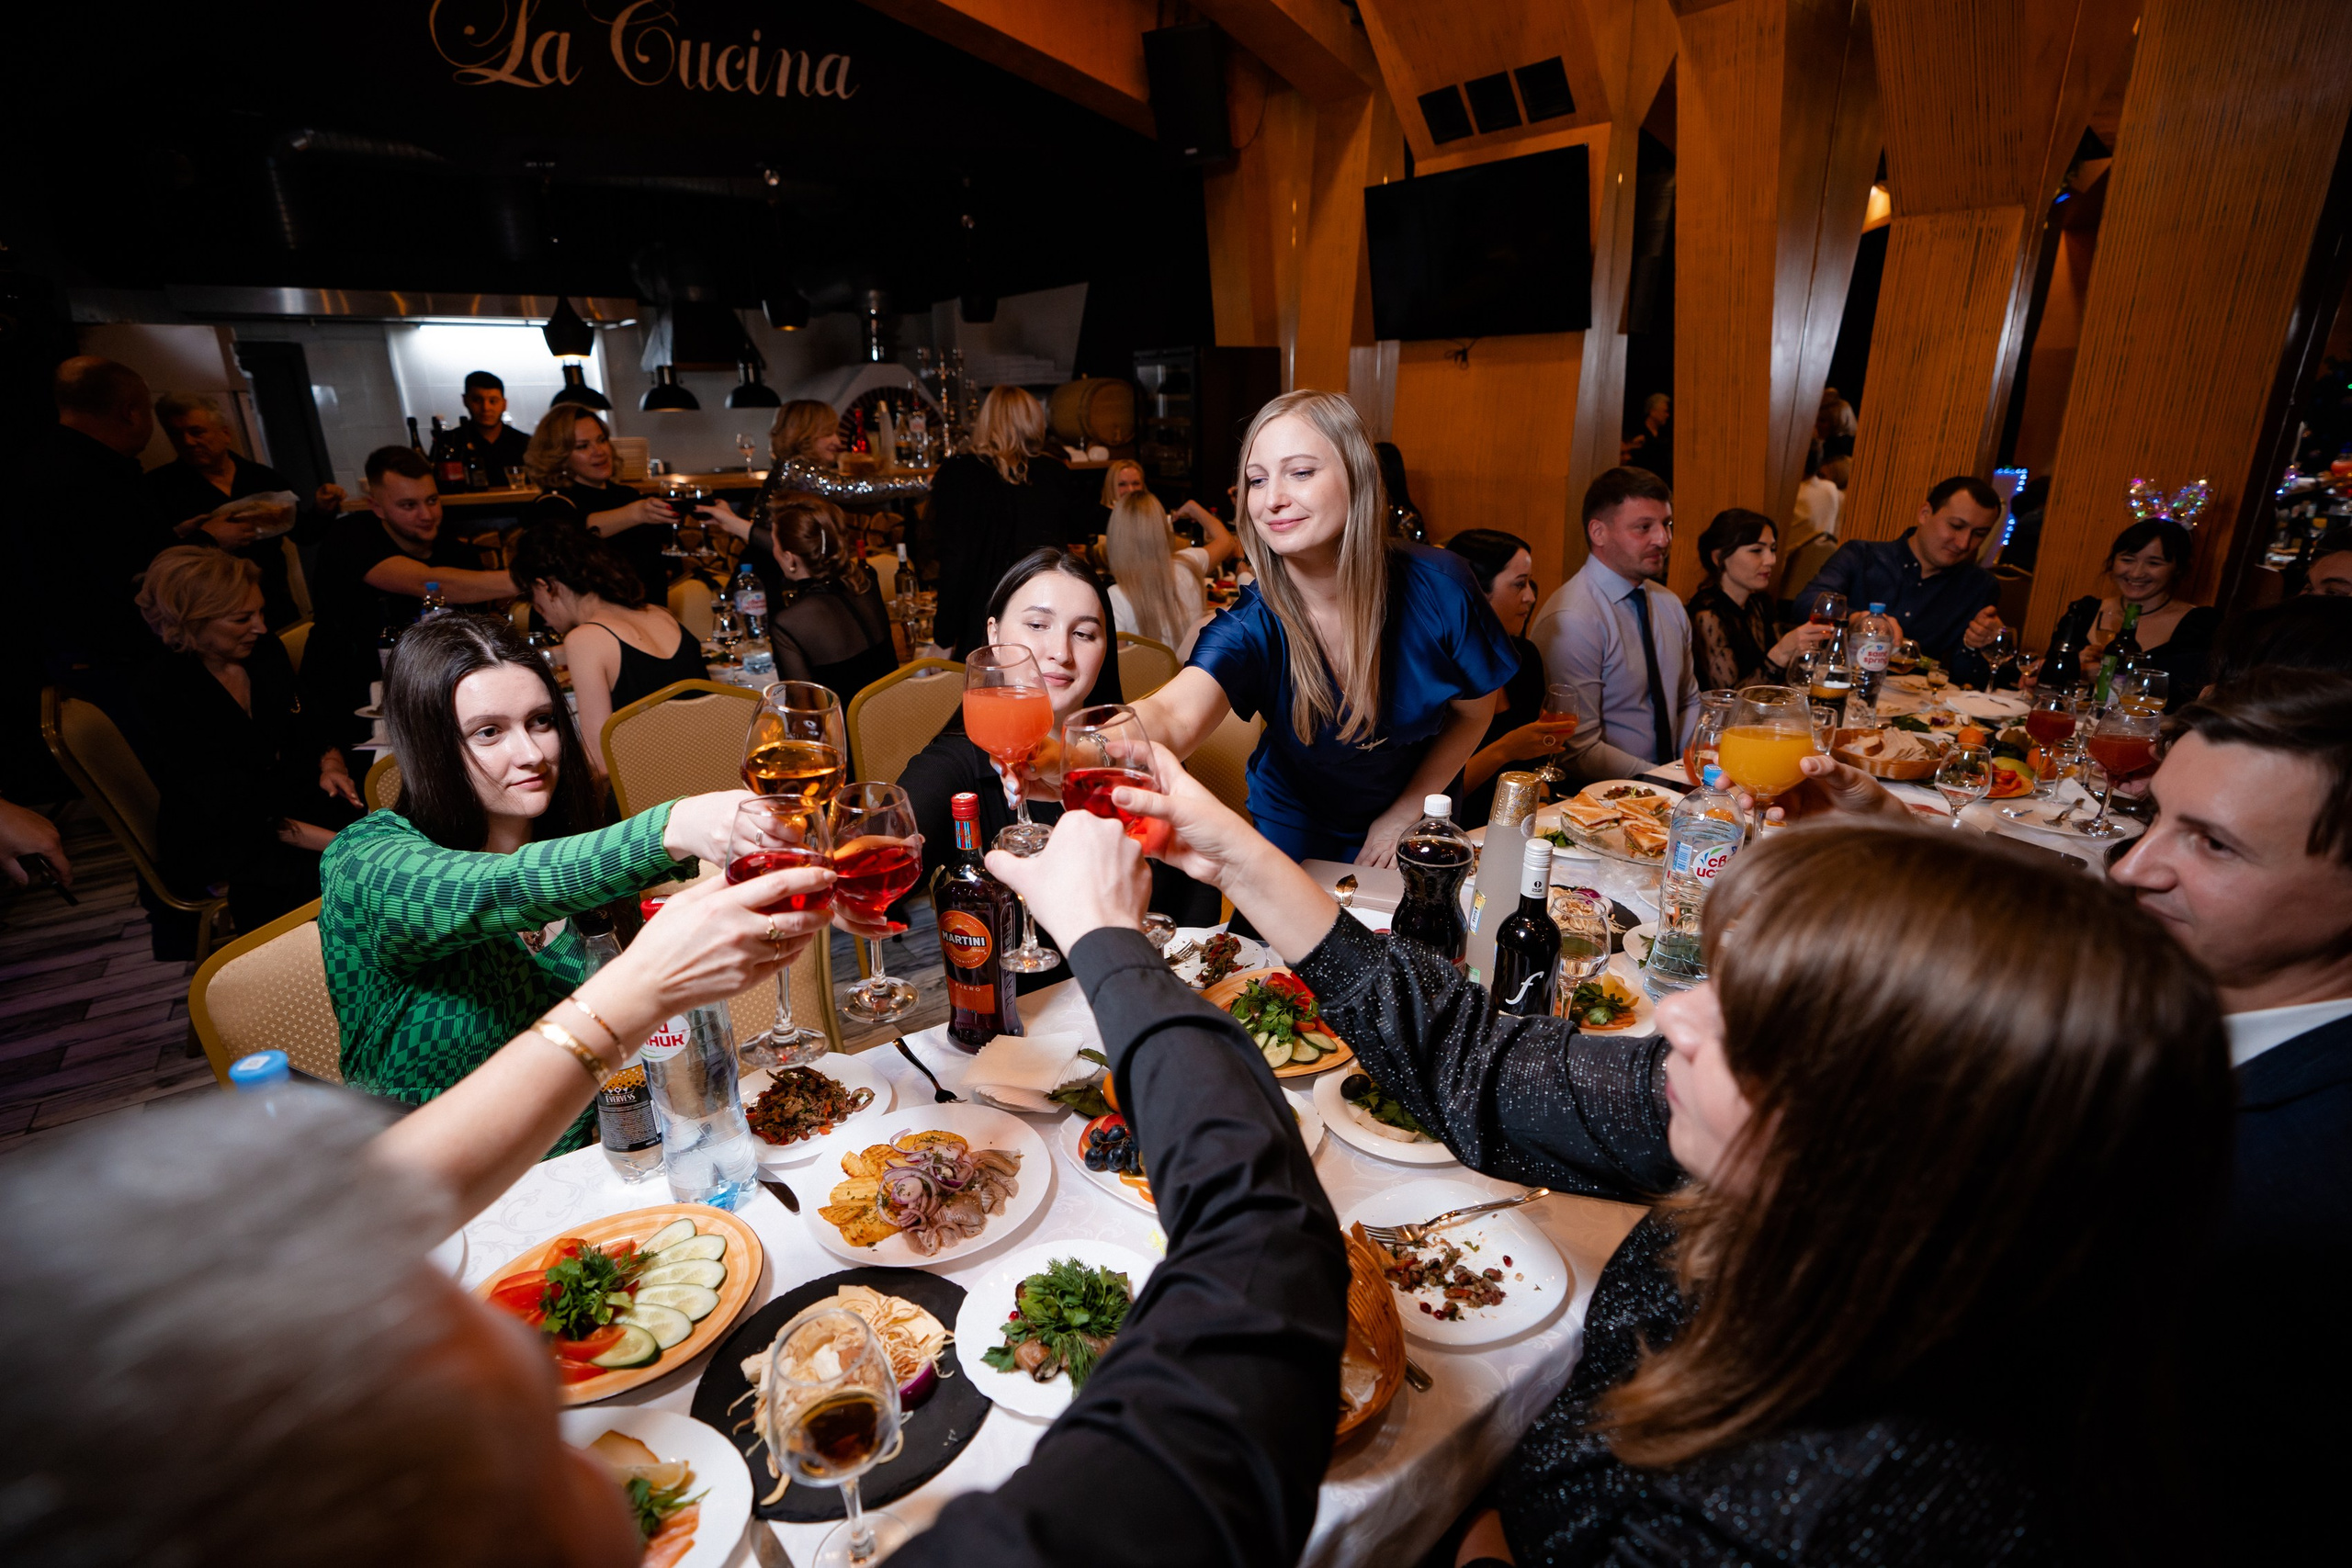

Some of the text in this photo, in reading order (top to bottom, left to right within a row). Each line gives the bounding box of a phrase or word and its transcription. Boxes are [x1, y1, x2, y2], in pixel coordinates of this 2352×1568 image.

[429, 0, 860, 100] La Cucina
[942, 930, 986, 947] MARTINI
[955, 982, 981, 992] FIERO
[605, 1092, 636, 1103] EVERVESS
